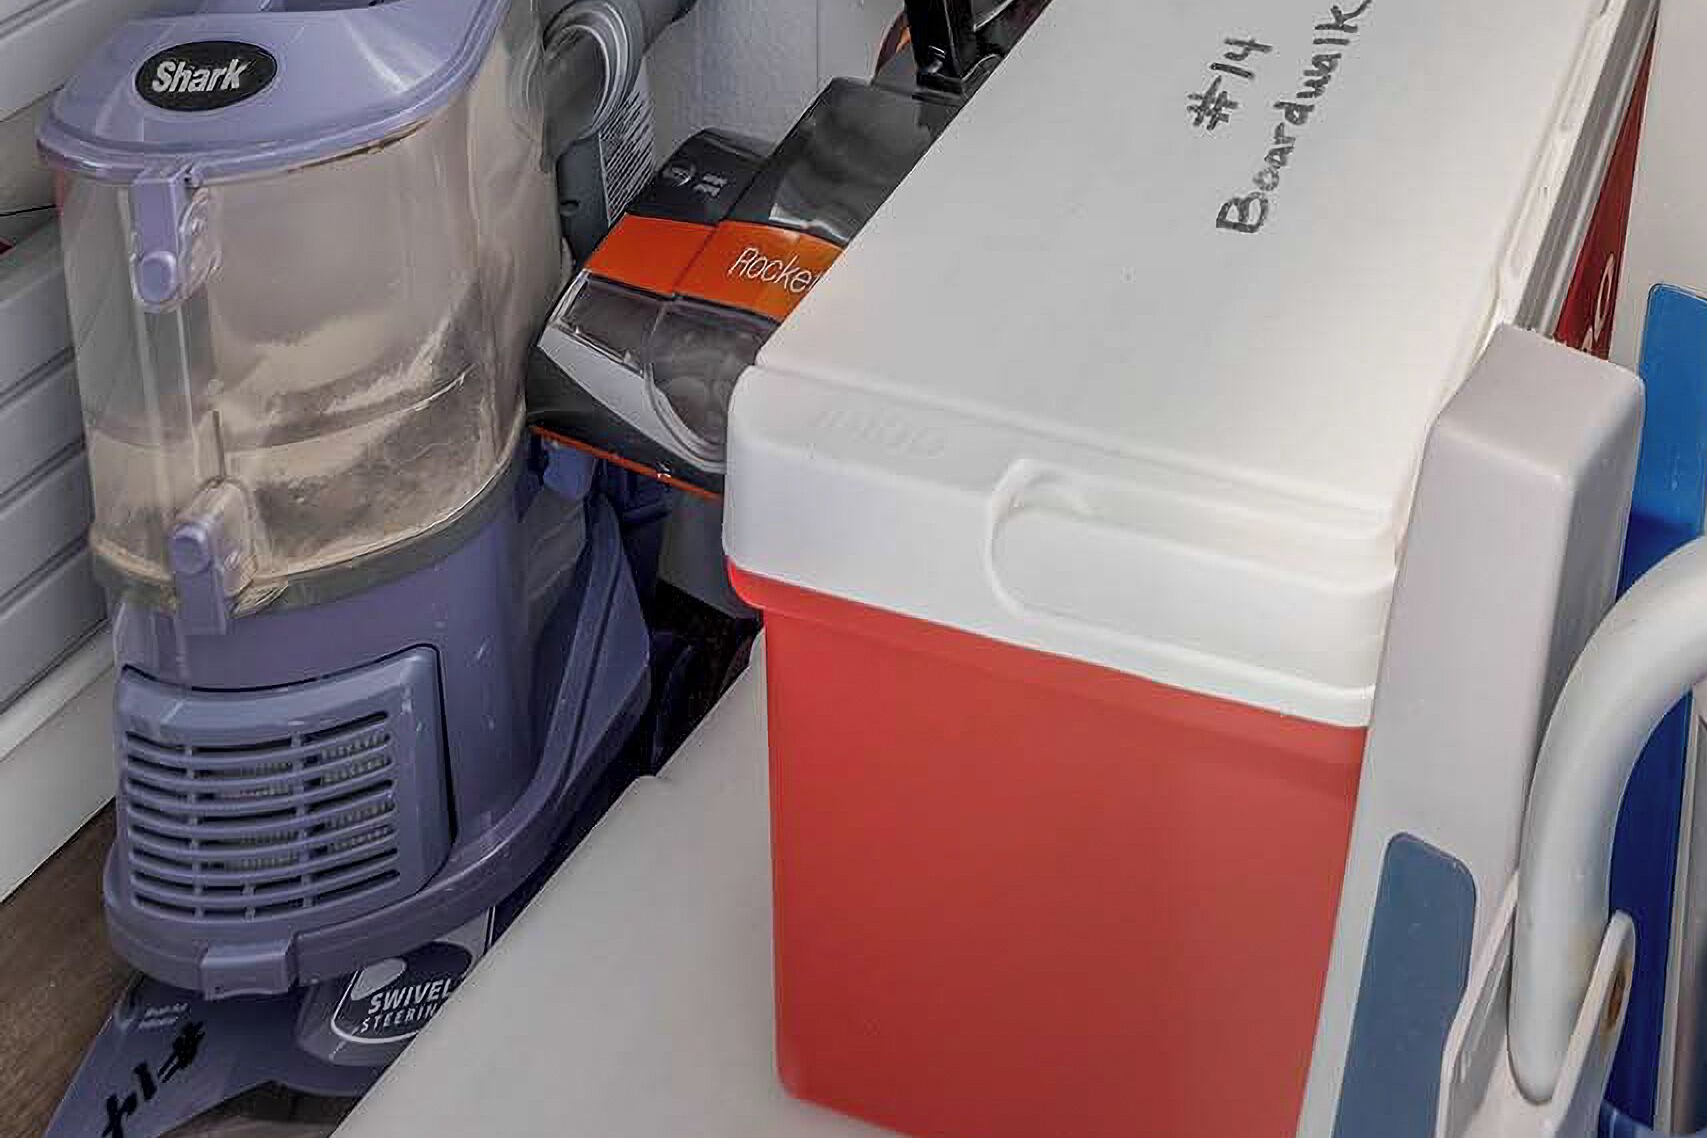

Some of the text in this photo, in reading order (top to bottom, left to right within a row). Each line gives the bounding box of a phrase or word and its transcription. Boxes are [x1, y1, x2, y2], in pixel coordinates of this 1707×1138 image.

[152, 59, 251, 92] Shark
[1187, 38, 1273, 130] #14
[368, 978, 451, 1014] SWIVEL
[360, 1003, 440, 1034] STEERIN
